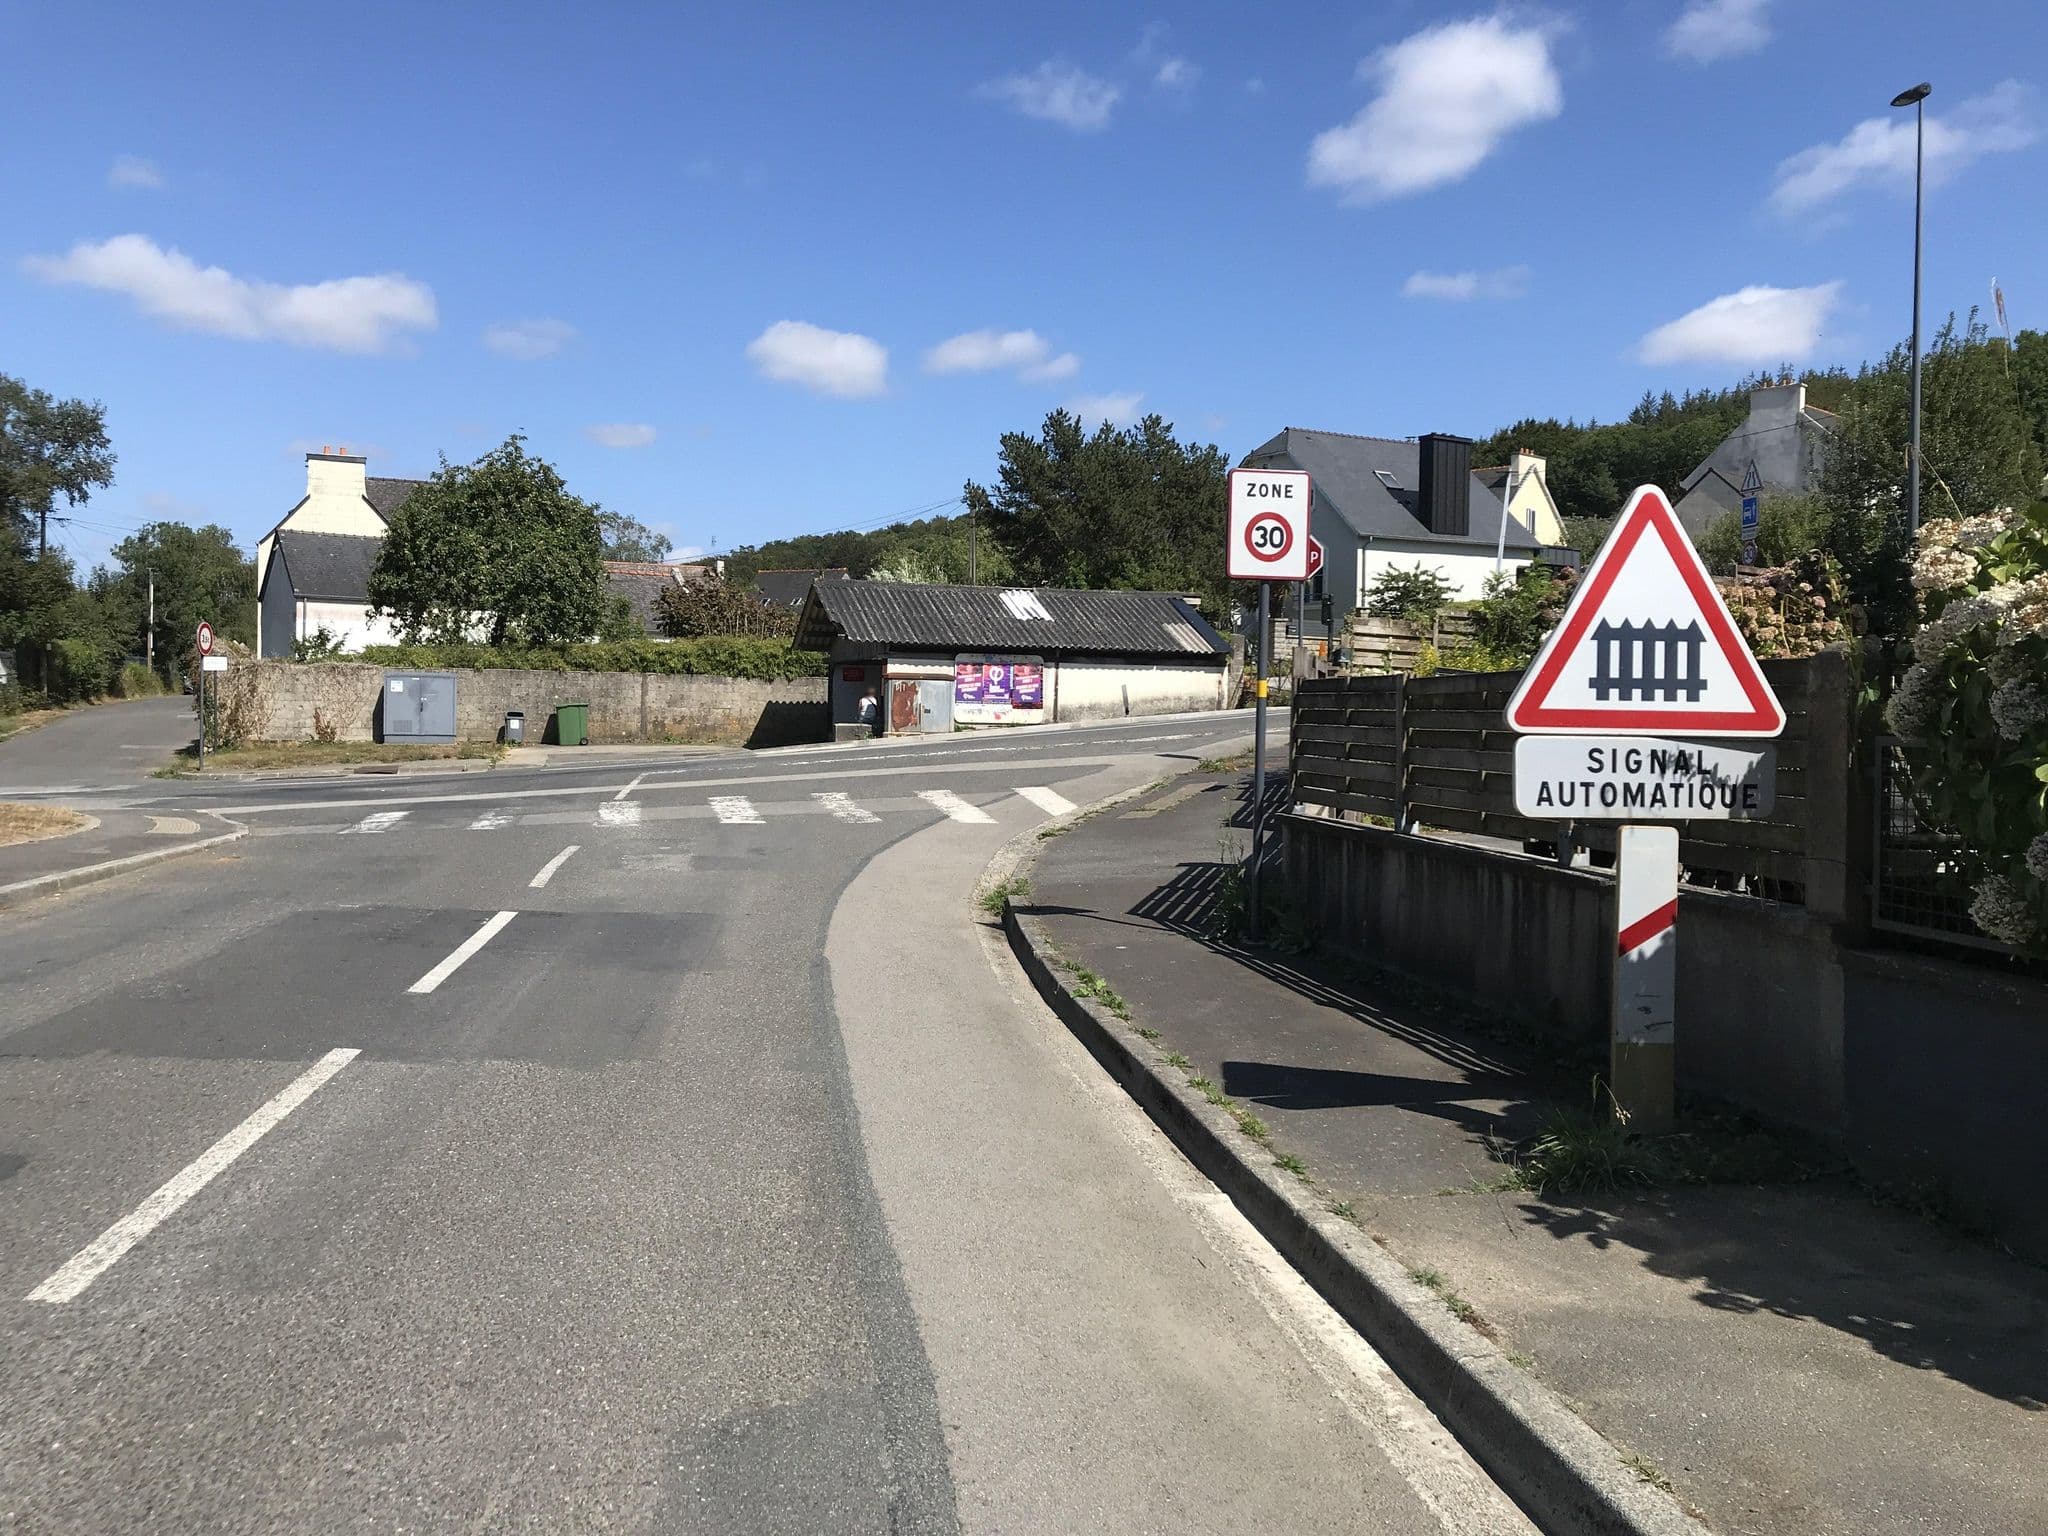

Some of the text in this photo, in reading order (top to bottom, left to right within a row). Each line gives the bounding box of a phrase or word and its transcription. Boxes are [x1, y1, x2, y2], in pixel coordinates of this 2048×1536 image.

[1247, 483, 1293, 498] ZONE
[1254, 526, 1284, 548] 30
[1587, 748, 1711, 775] SIGNAL
[1536, 781, 1758, 809] AUTOMATIQUE
